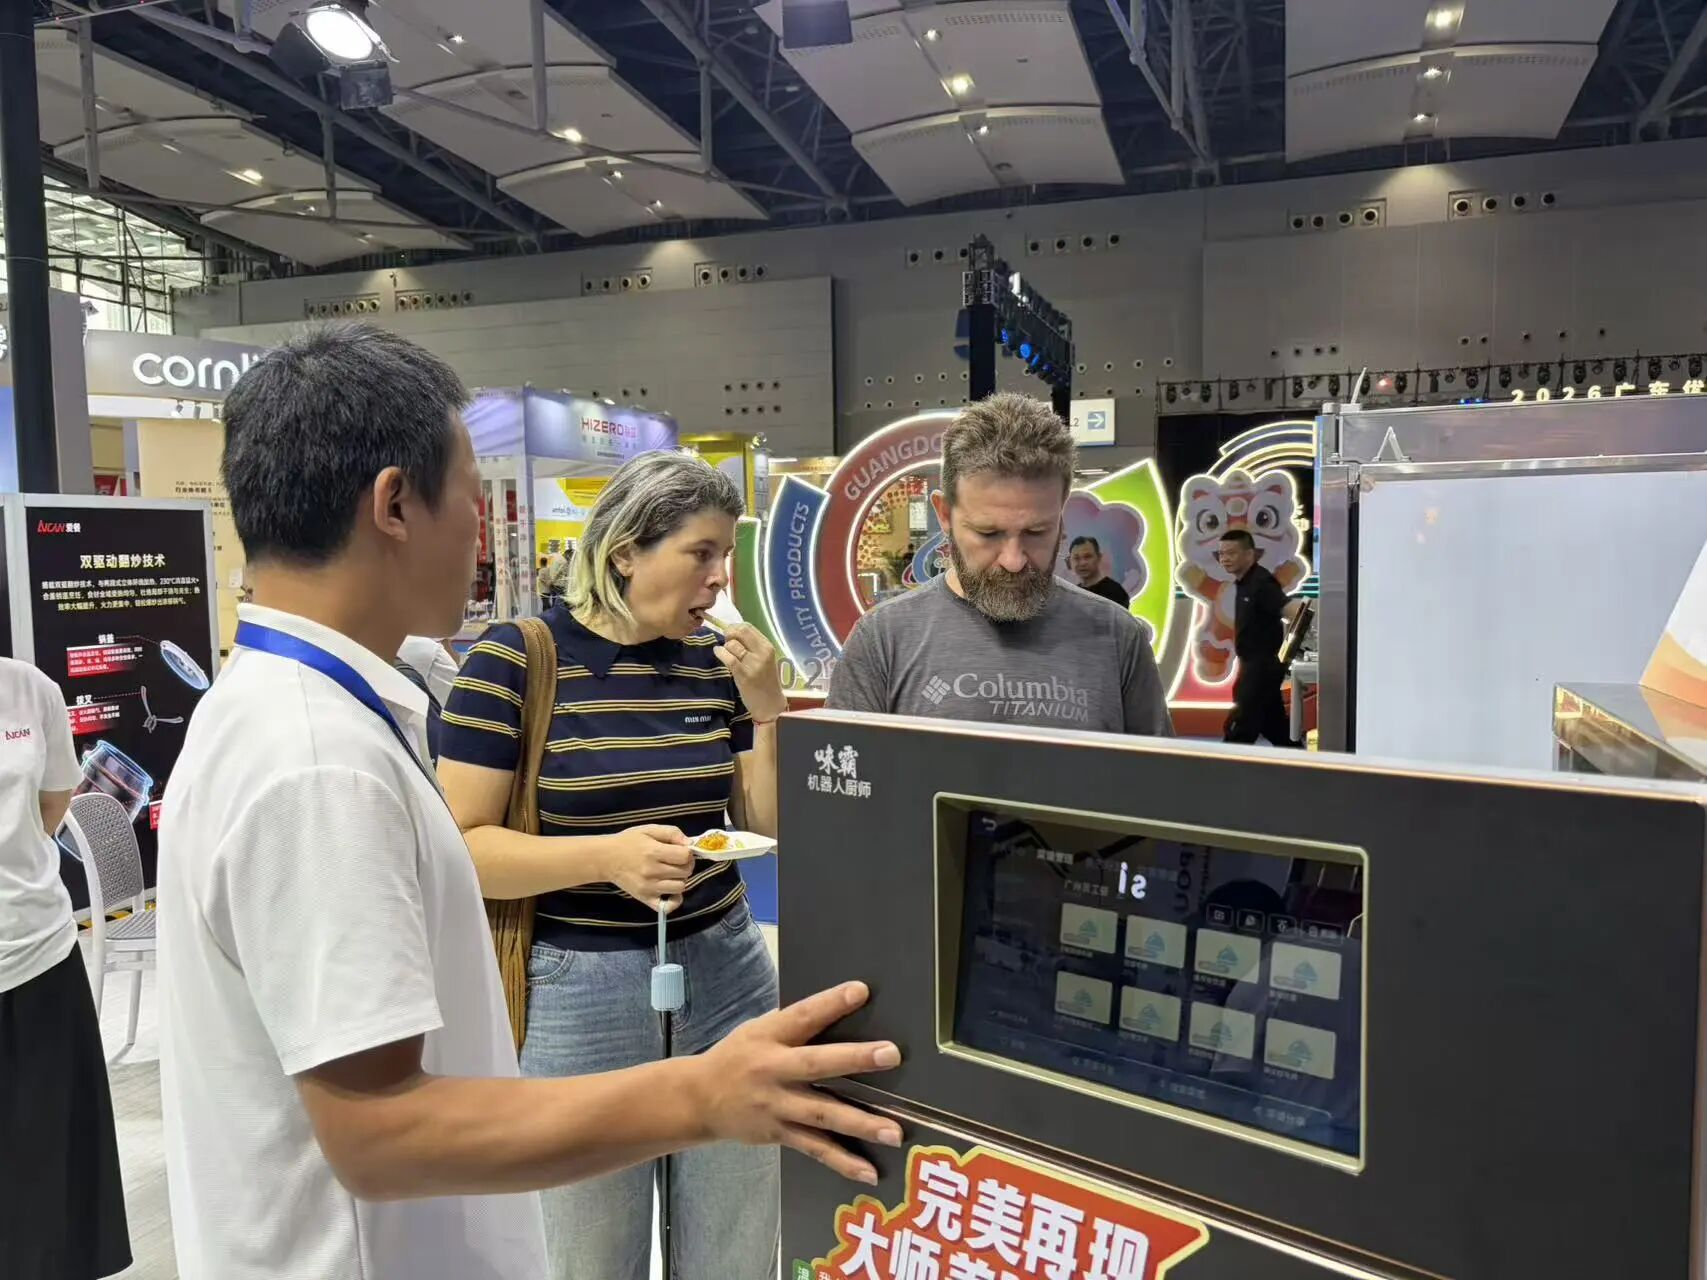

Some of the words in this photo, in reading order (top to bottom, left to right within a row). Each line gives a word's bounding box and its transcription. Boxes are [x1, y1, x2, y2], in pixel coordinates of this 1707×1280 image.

[581, 416, 624, 436] HIZERO
[80, 553, 166, 569] 双驱动翻炒技术
[787, 501, 809, 601] PRODUCTS
[794, 605, 833, 663] UALITY
[953, 673, 1089, 707] Columbia
[989, 700, 1089, 723] TITANIUM
[814, 743, 859, 779] 味霸
[807, 773, 872, 798] 机器人厨师
[911, 1159, 1149, 1280] 完美再现
[838, 1211, 1026, 1280] 大师
